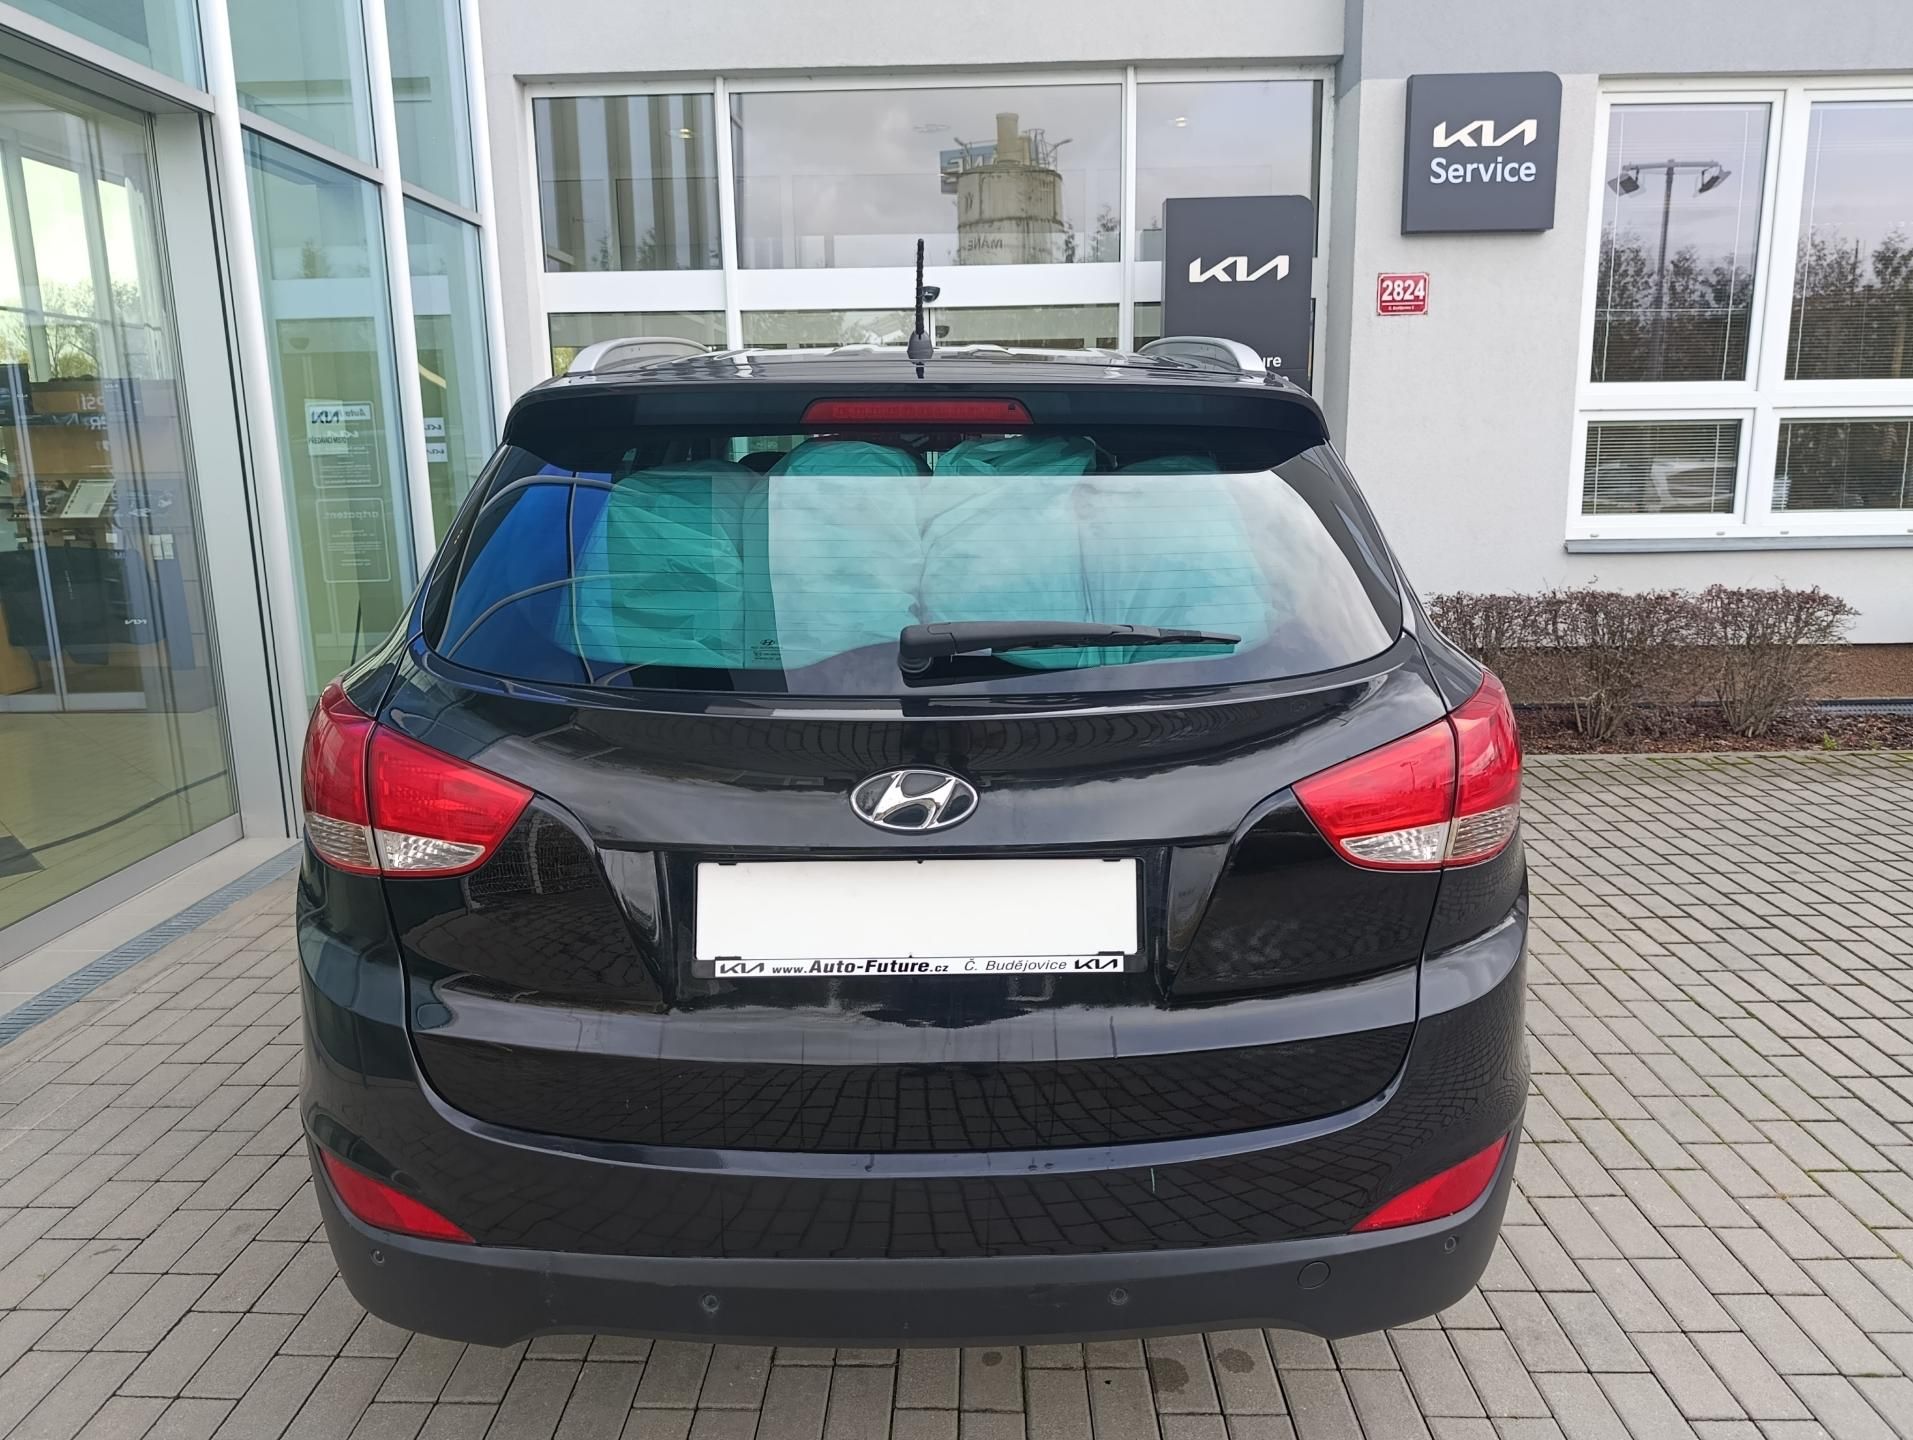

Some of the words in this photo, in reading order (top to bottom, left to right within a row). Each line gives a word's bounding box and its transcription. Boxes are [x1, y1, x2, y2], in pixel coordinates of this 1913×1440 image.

[1433, 119, 1537, 148] KIA
[1429, 156, 1537, 184] Service
[1189, 255, 1290, 283] KIA
[1381, 279, 1425, 301] 2824
[719, 961, 765, 974] KIA
[772, 959, 949, 974] www.Auto-Future.cz
[964, 957, 978, 972] Č.
[985, 958, 1067, 972] Budějovice
[1074, 958, 1118, 970] KIA
